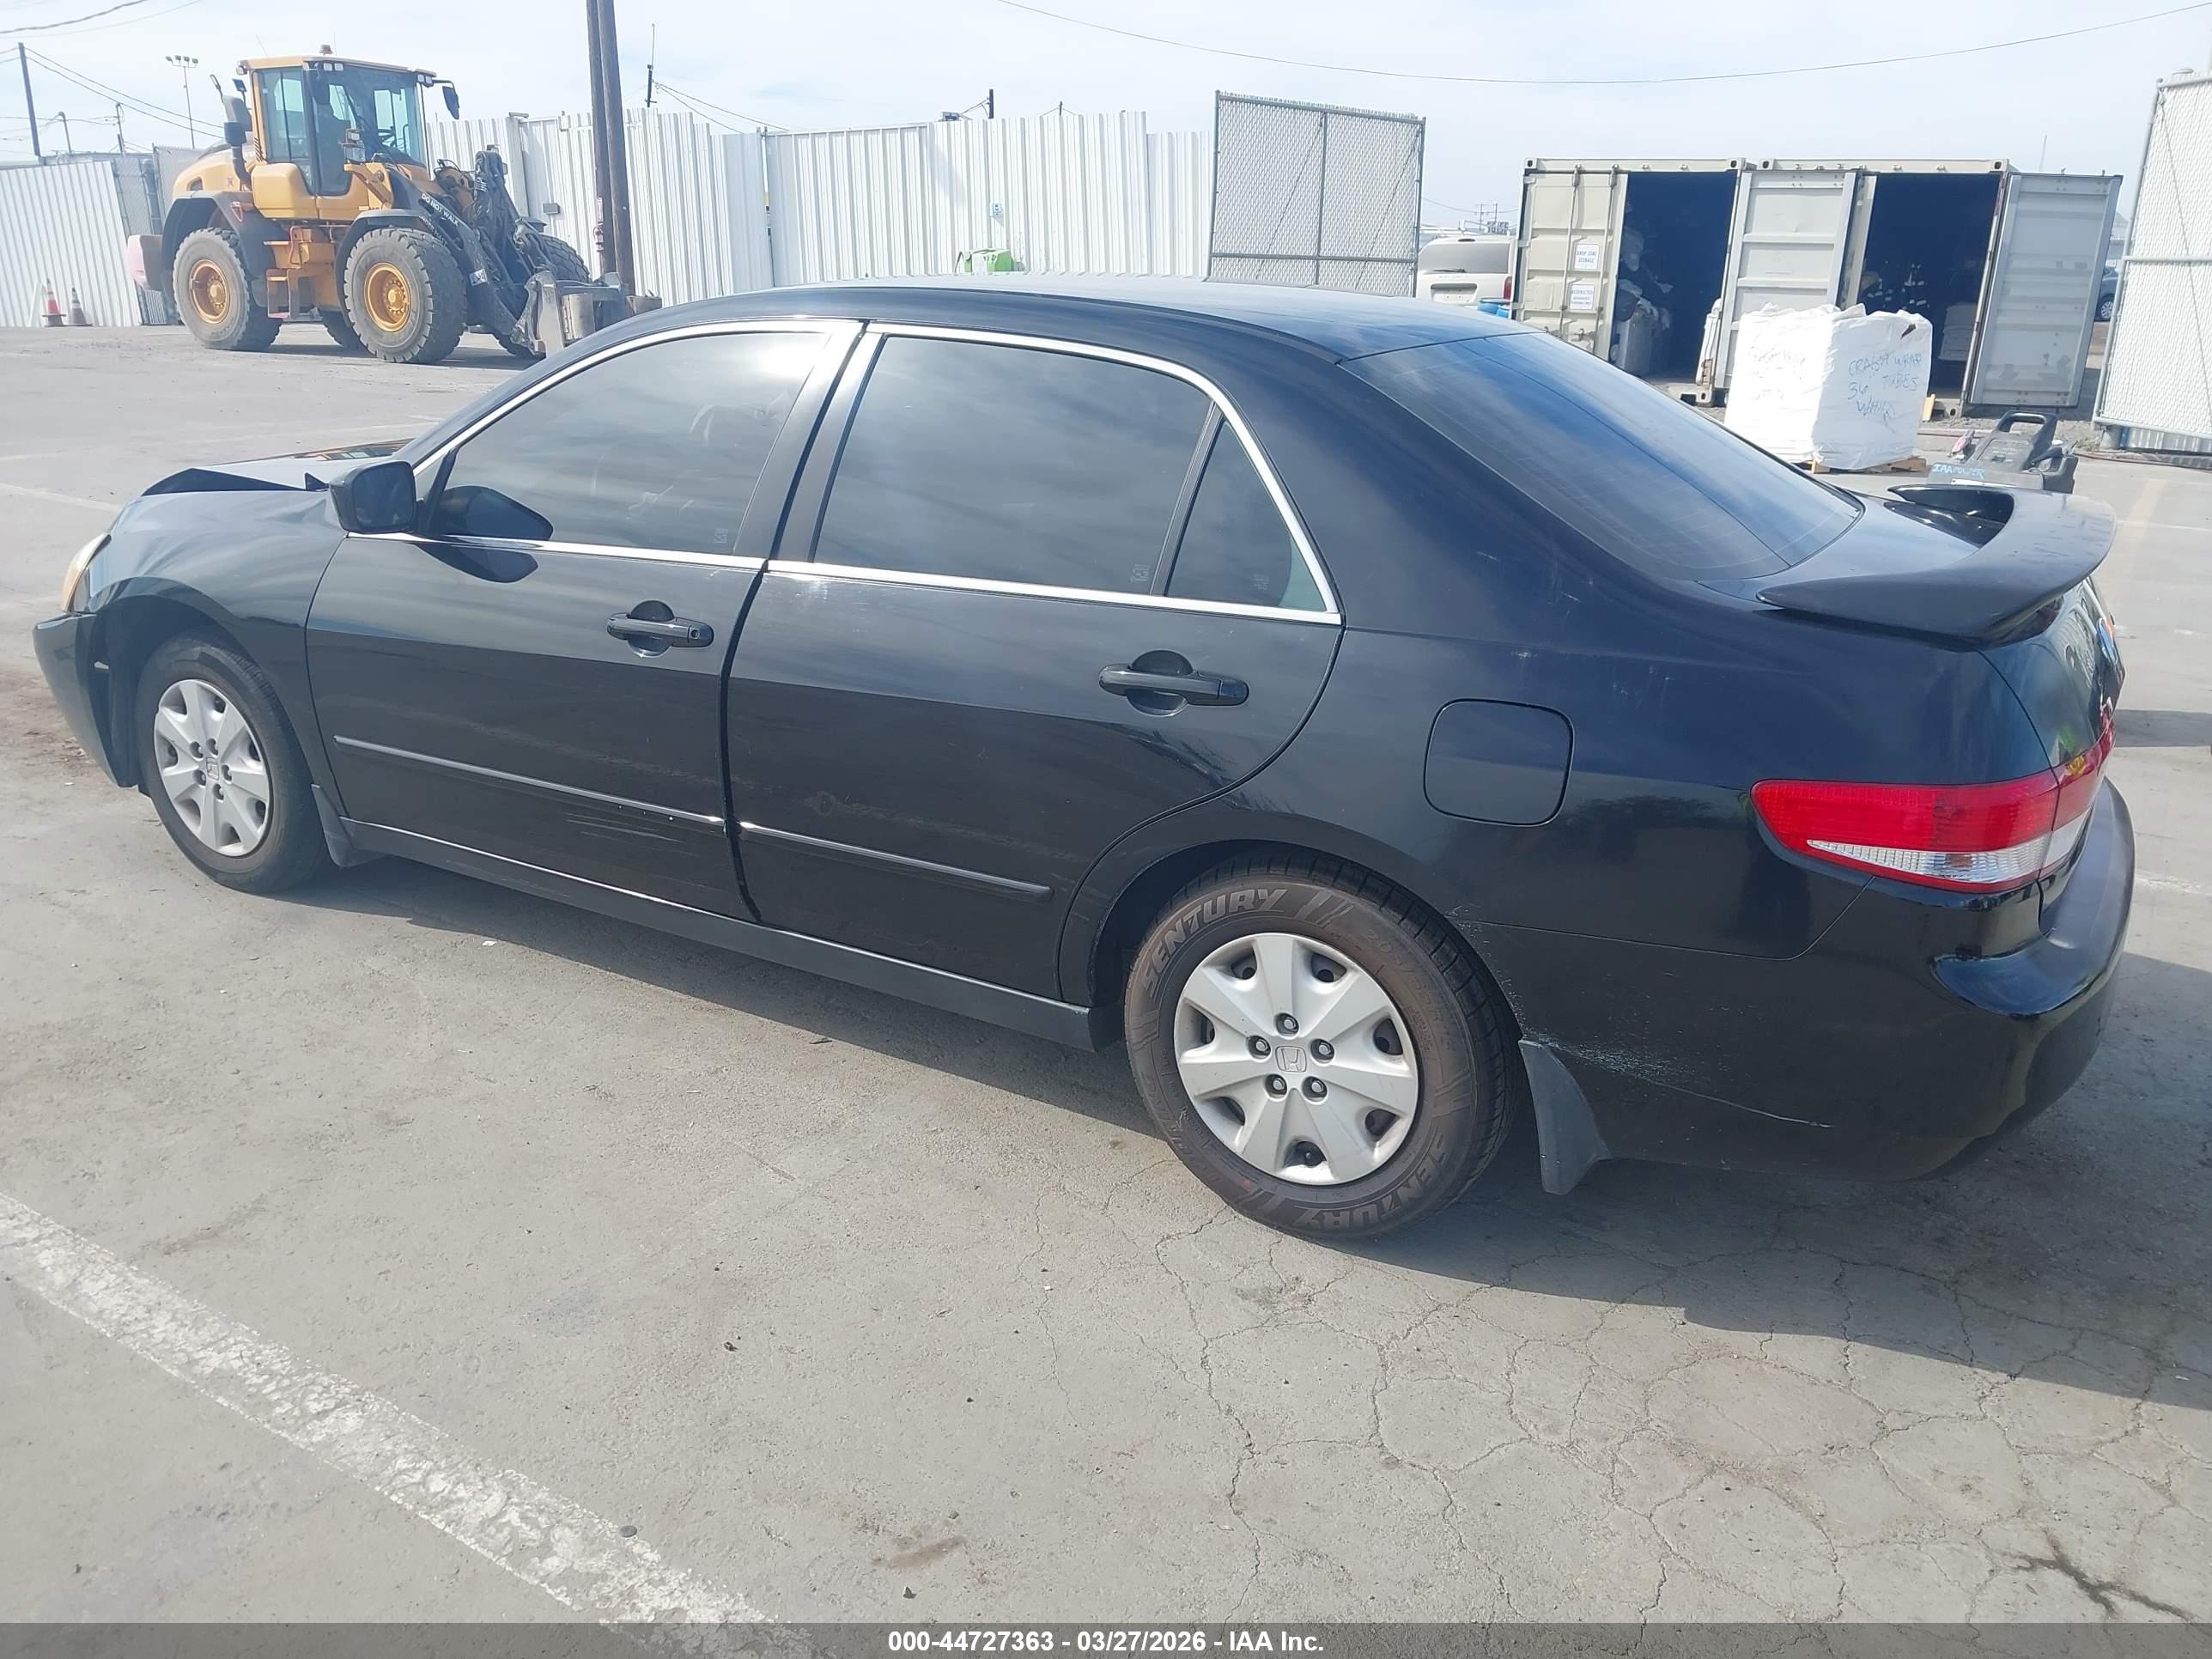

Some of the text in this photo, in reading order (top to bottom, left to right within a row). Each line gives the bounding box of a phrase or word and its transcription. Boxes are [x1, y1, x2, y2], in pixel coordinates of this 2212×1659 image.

[421, 193, 459, 227] DO NOT WALK
[1140, 889, 1288, 998] SENTURY
